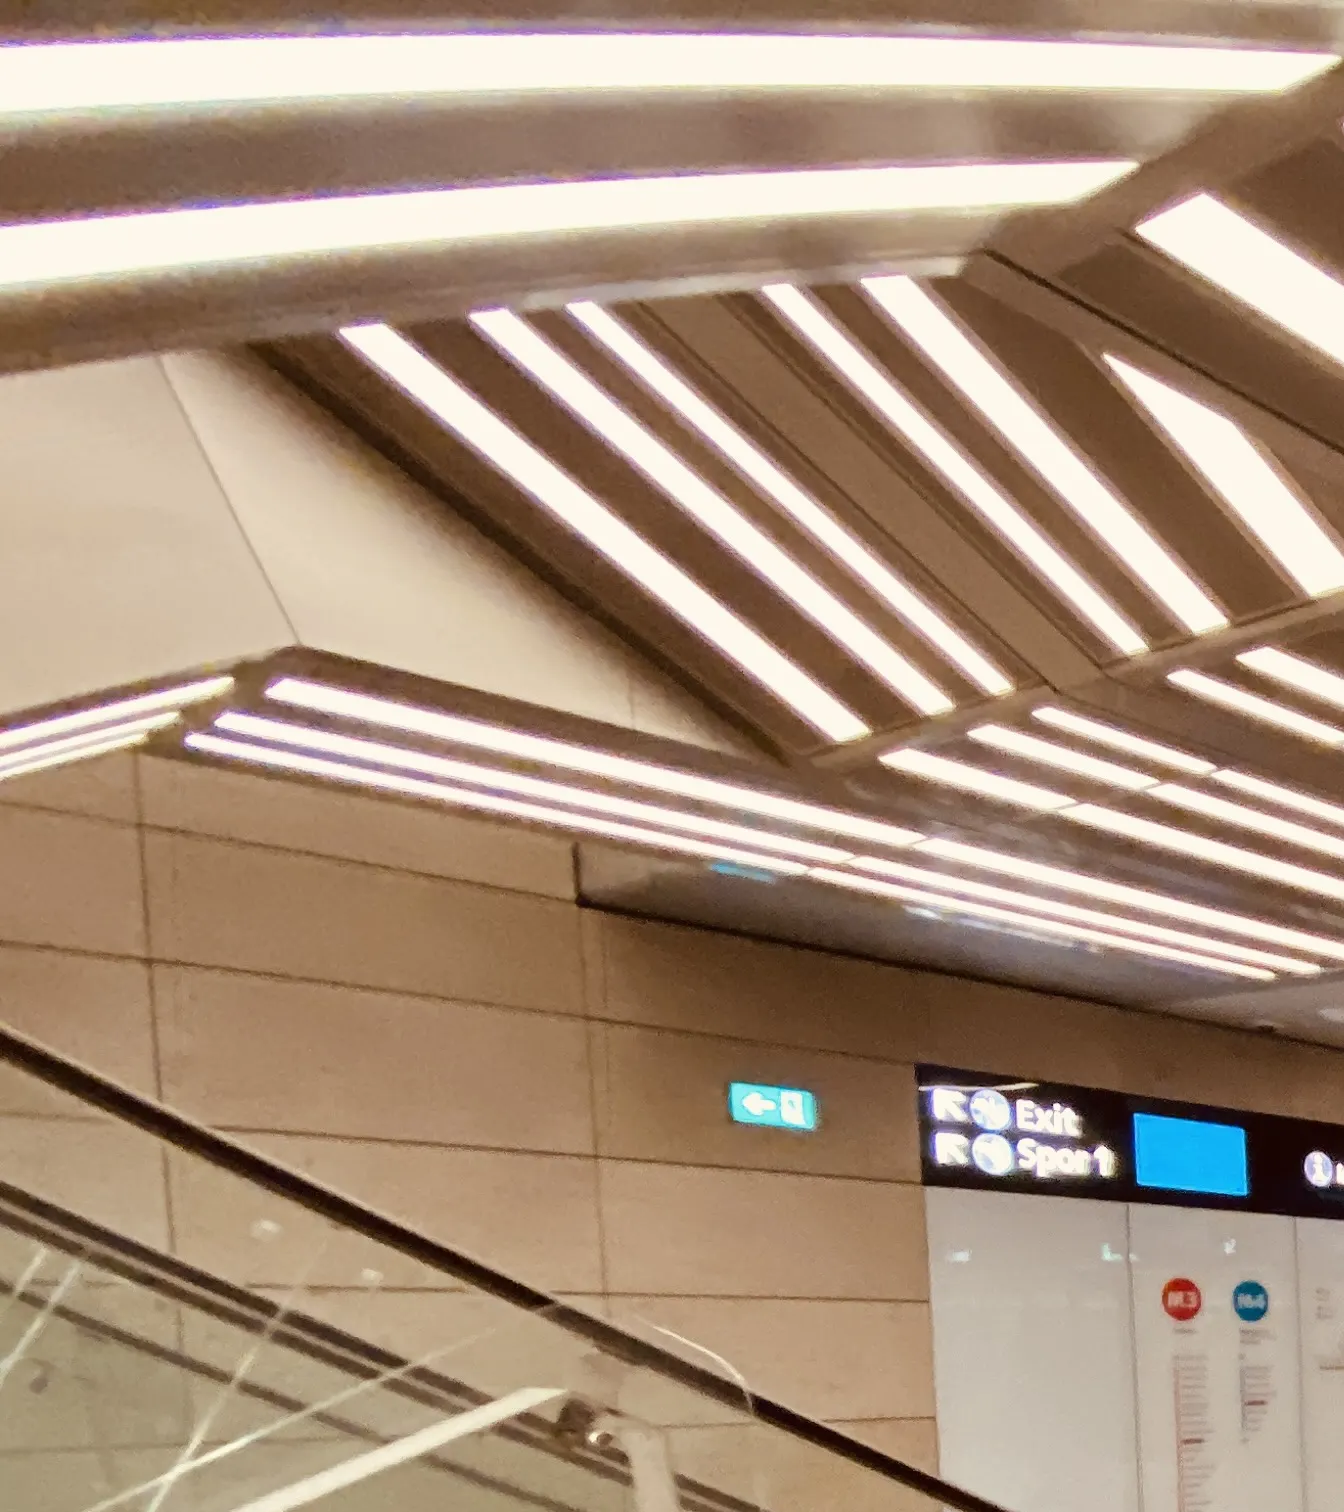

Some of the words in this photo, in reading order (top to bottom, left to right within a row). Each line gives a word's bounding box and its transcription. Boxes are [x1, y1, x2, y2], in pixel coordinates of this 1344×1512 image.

[1016, 1099, 1082, 1137] Exit
[1016, 1137, 1090, 1178] Spor
[1093, 1143, 1116, 1178] 1
